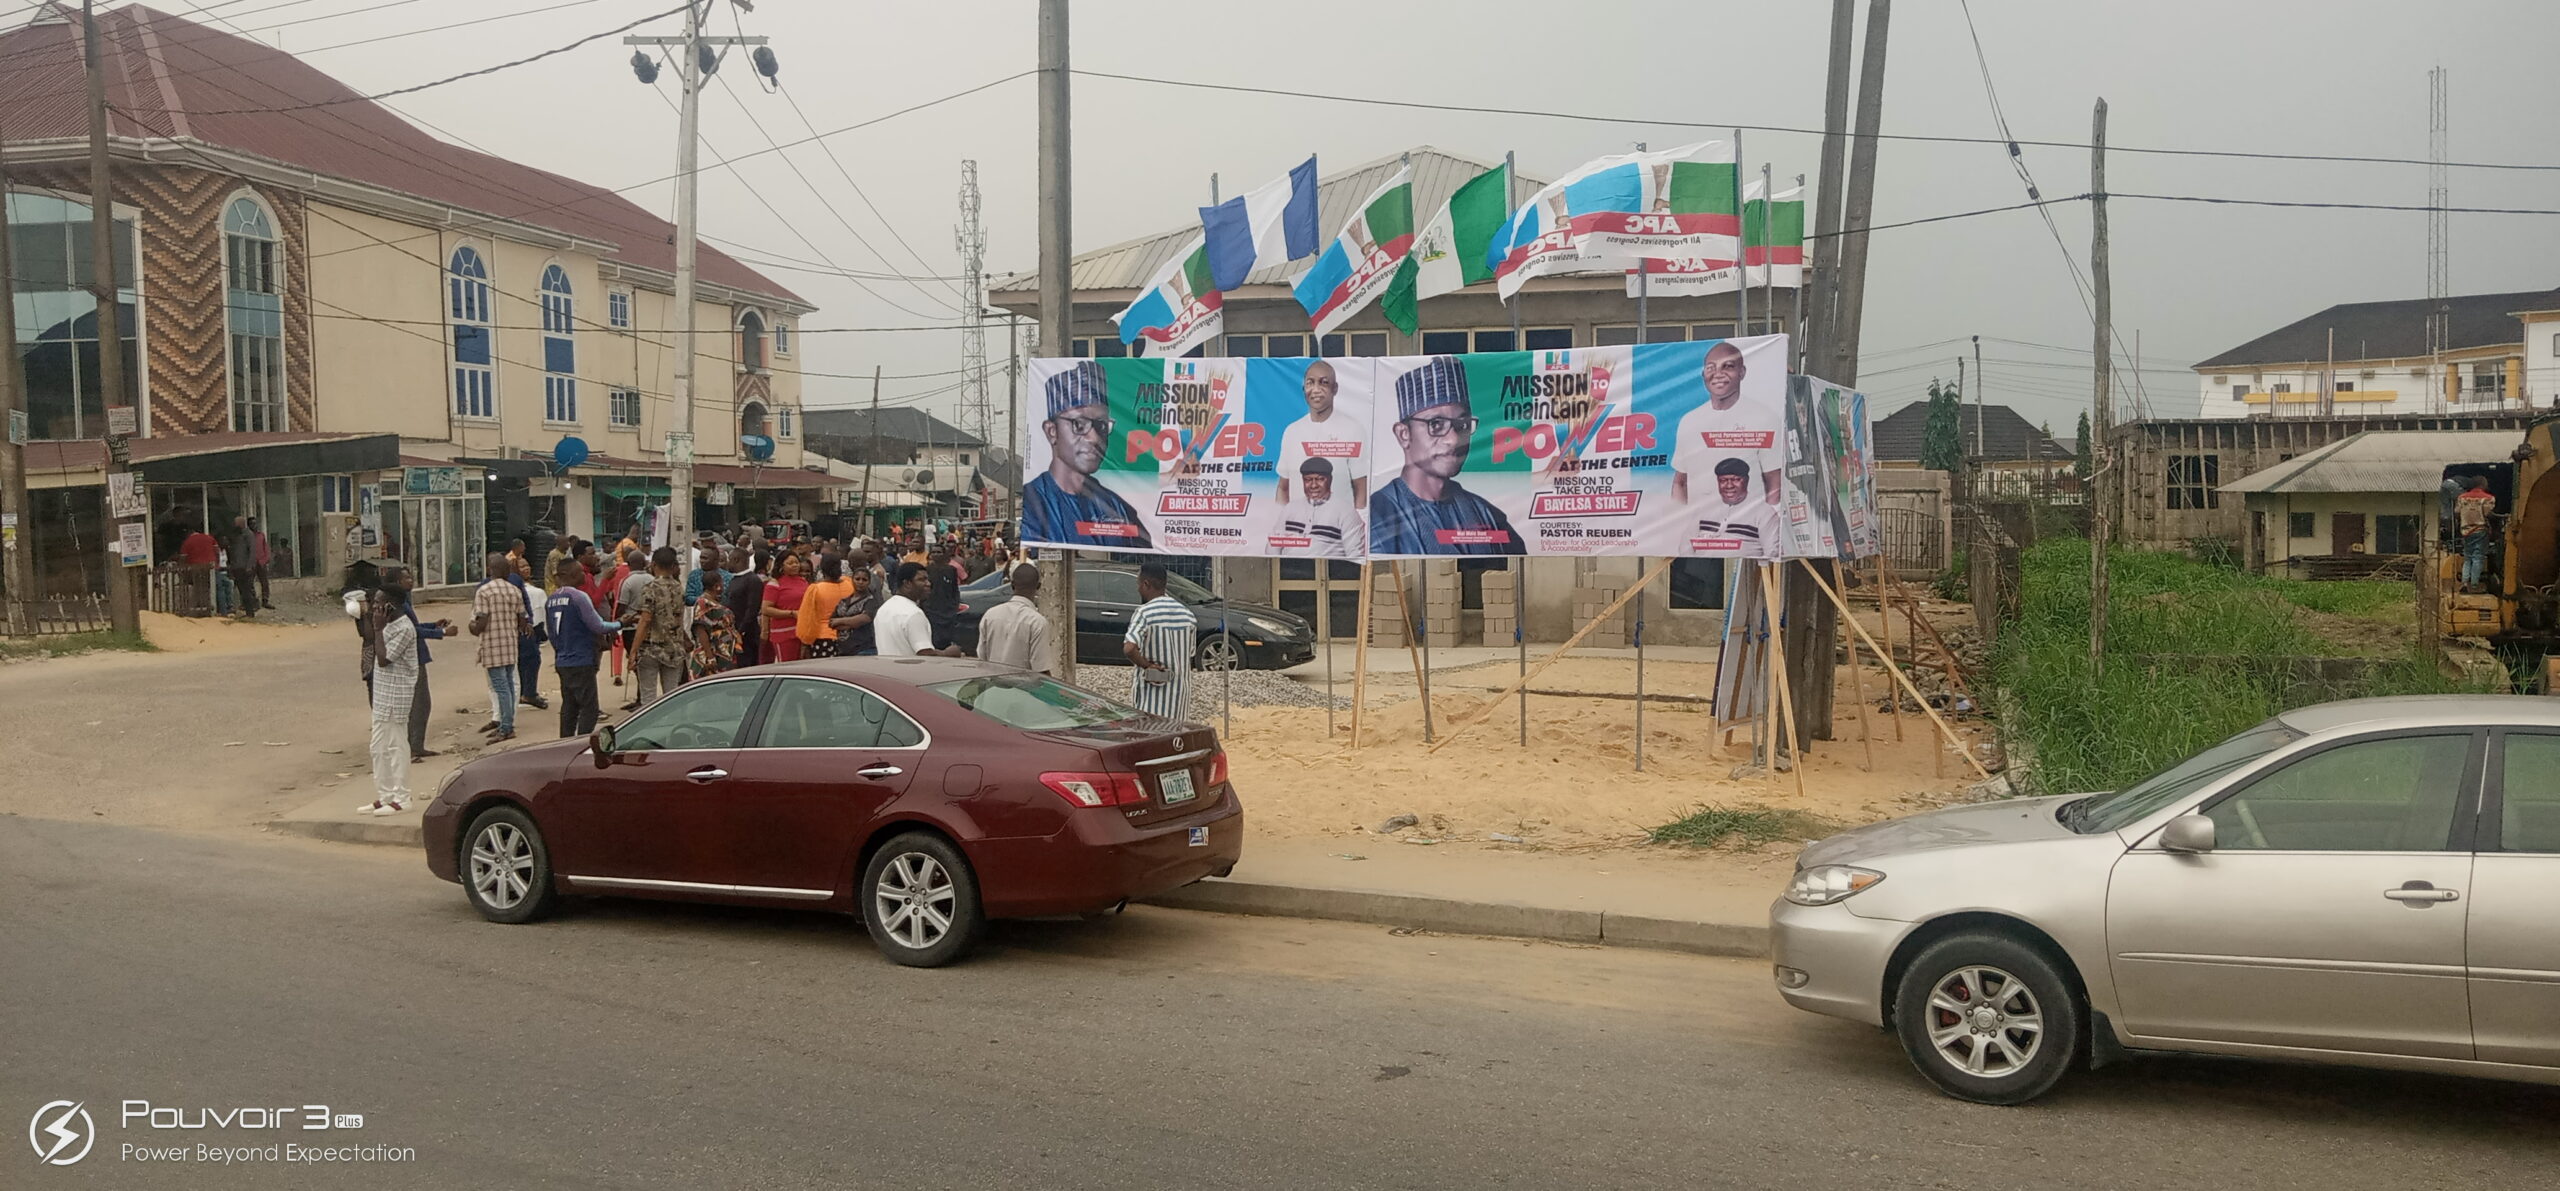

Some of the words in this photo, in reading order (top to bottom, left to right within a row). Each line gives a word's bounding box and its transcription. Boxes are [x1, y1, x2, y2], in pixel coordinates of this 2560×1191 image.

[1133, 383, 1209, 410] MISSION
[1212, 390, 1226, 400] TO
[1499, 373, 1588, 407] MISSION
[1591, 379, 1608, 390] TO
[1137, 405, 1208, 426] maintain
[1504, 399, 1588, 421] maintain
[1126, 413, 1265, 463] POWER
[1491, 403, 1657, 463] POWER
[1182, 463, 1201, 475] AT
[1201, 463, 1223, 474] THE
[1226, 460, 1273, 474] CENTRE
[1559, 460, 1581, 472] AT
[1581, 459, 1607, 471] THE
[1610, 454, 1668, 469] CENTRE
[1177, 478, 1213, 488] MISSION
[1216, 479, 1228, 488] TO
[1554, 477, 1596, 486] MISSION
[1600, 476, 1614, 486] TO
[1178, 486, 1200, 496] TAKE
[1202, 487, 1227, 496] OVER
[1555, 486, 1581, 495] TAKE
[1584, 486, 1612, 495] OVER
[1168, 497, 1209, 511] BAYELSA
[1211, 498, 1240, 511] STATE
[1544, 497, 1592, 512] BAYELSA
[1595, 496, 1628, 510] STATE
[1164, 519, 1201, 528] COURTESY:
[1164, 526, 1201, 536] PASTOR
[1203, 527, 1242, 537] REUBEN
[1540, 529, 1583, 538] PASTOR
[1586, 529, 1632, 538] REUBEN
[1198, 536, 1215, 544] Good
[1216, 537, 1248, 546] Leadership
[1548, 545, 1592, 553] Accountability
[554, 611, 562, 636] 7
